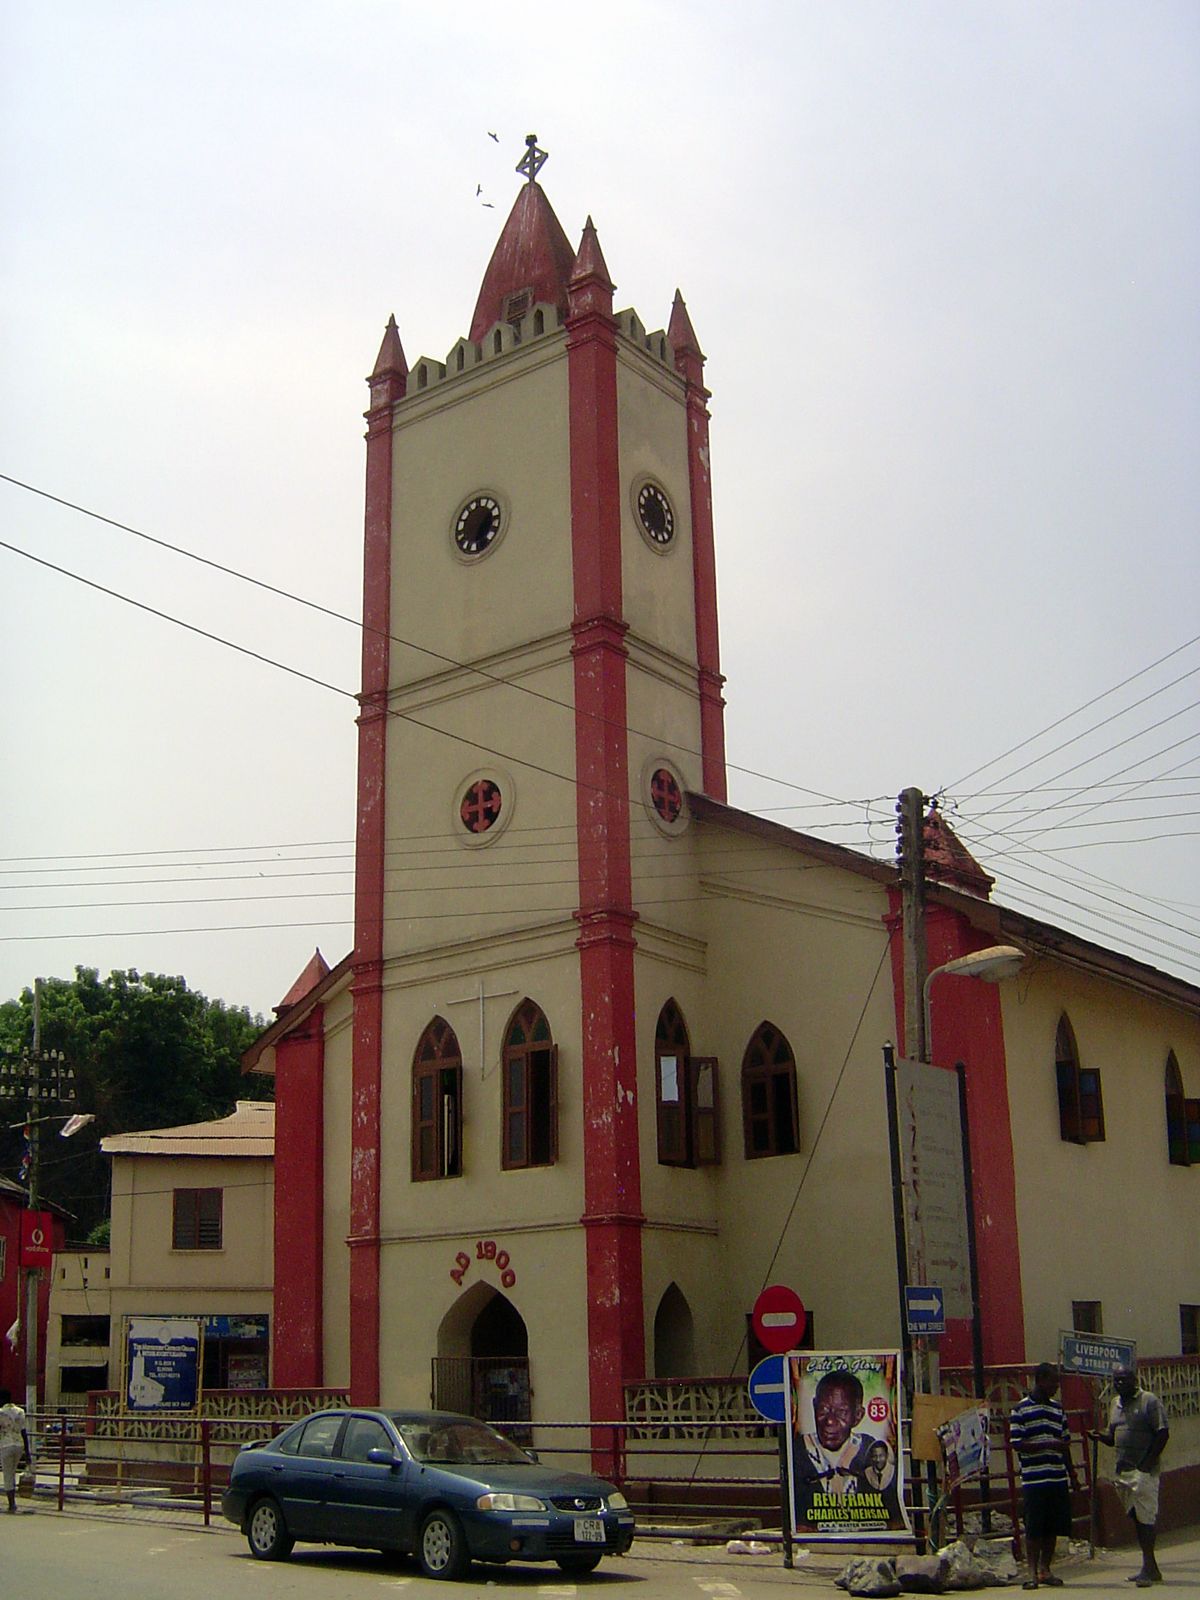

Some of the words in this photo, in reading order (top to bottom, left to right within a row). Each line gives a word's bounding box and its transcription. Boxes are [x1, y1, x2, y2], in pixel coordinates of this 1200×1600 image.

[1076, 1344, 1120, 1359] LIVERPOOL
[806, 1359, 832, 1372] Call
[834, 1359, 848, 1370] To
[851, 1359, 882, 1373] Glory
[1085, 1358, 1109, 1369] STREET
[870, 1405, 886, 1417] 83
[813, 1492, 840, 1507] REV.
[841, 1492, 884, 1507] FRANK
[807, 1508, 849, 1520] CHARLES
[850, 1508, 890, 1519] MENSAH
[583, 1520, 595, 1530] CR
